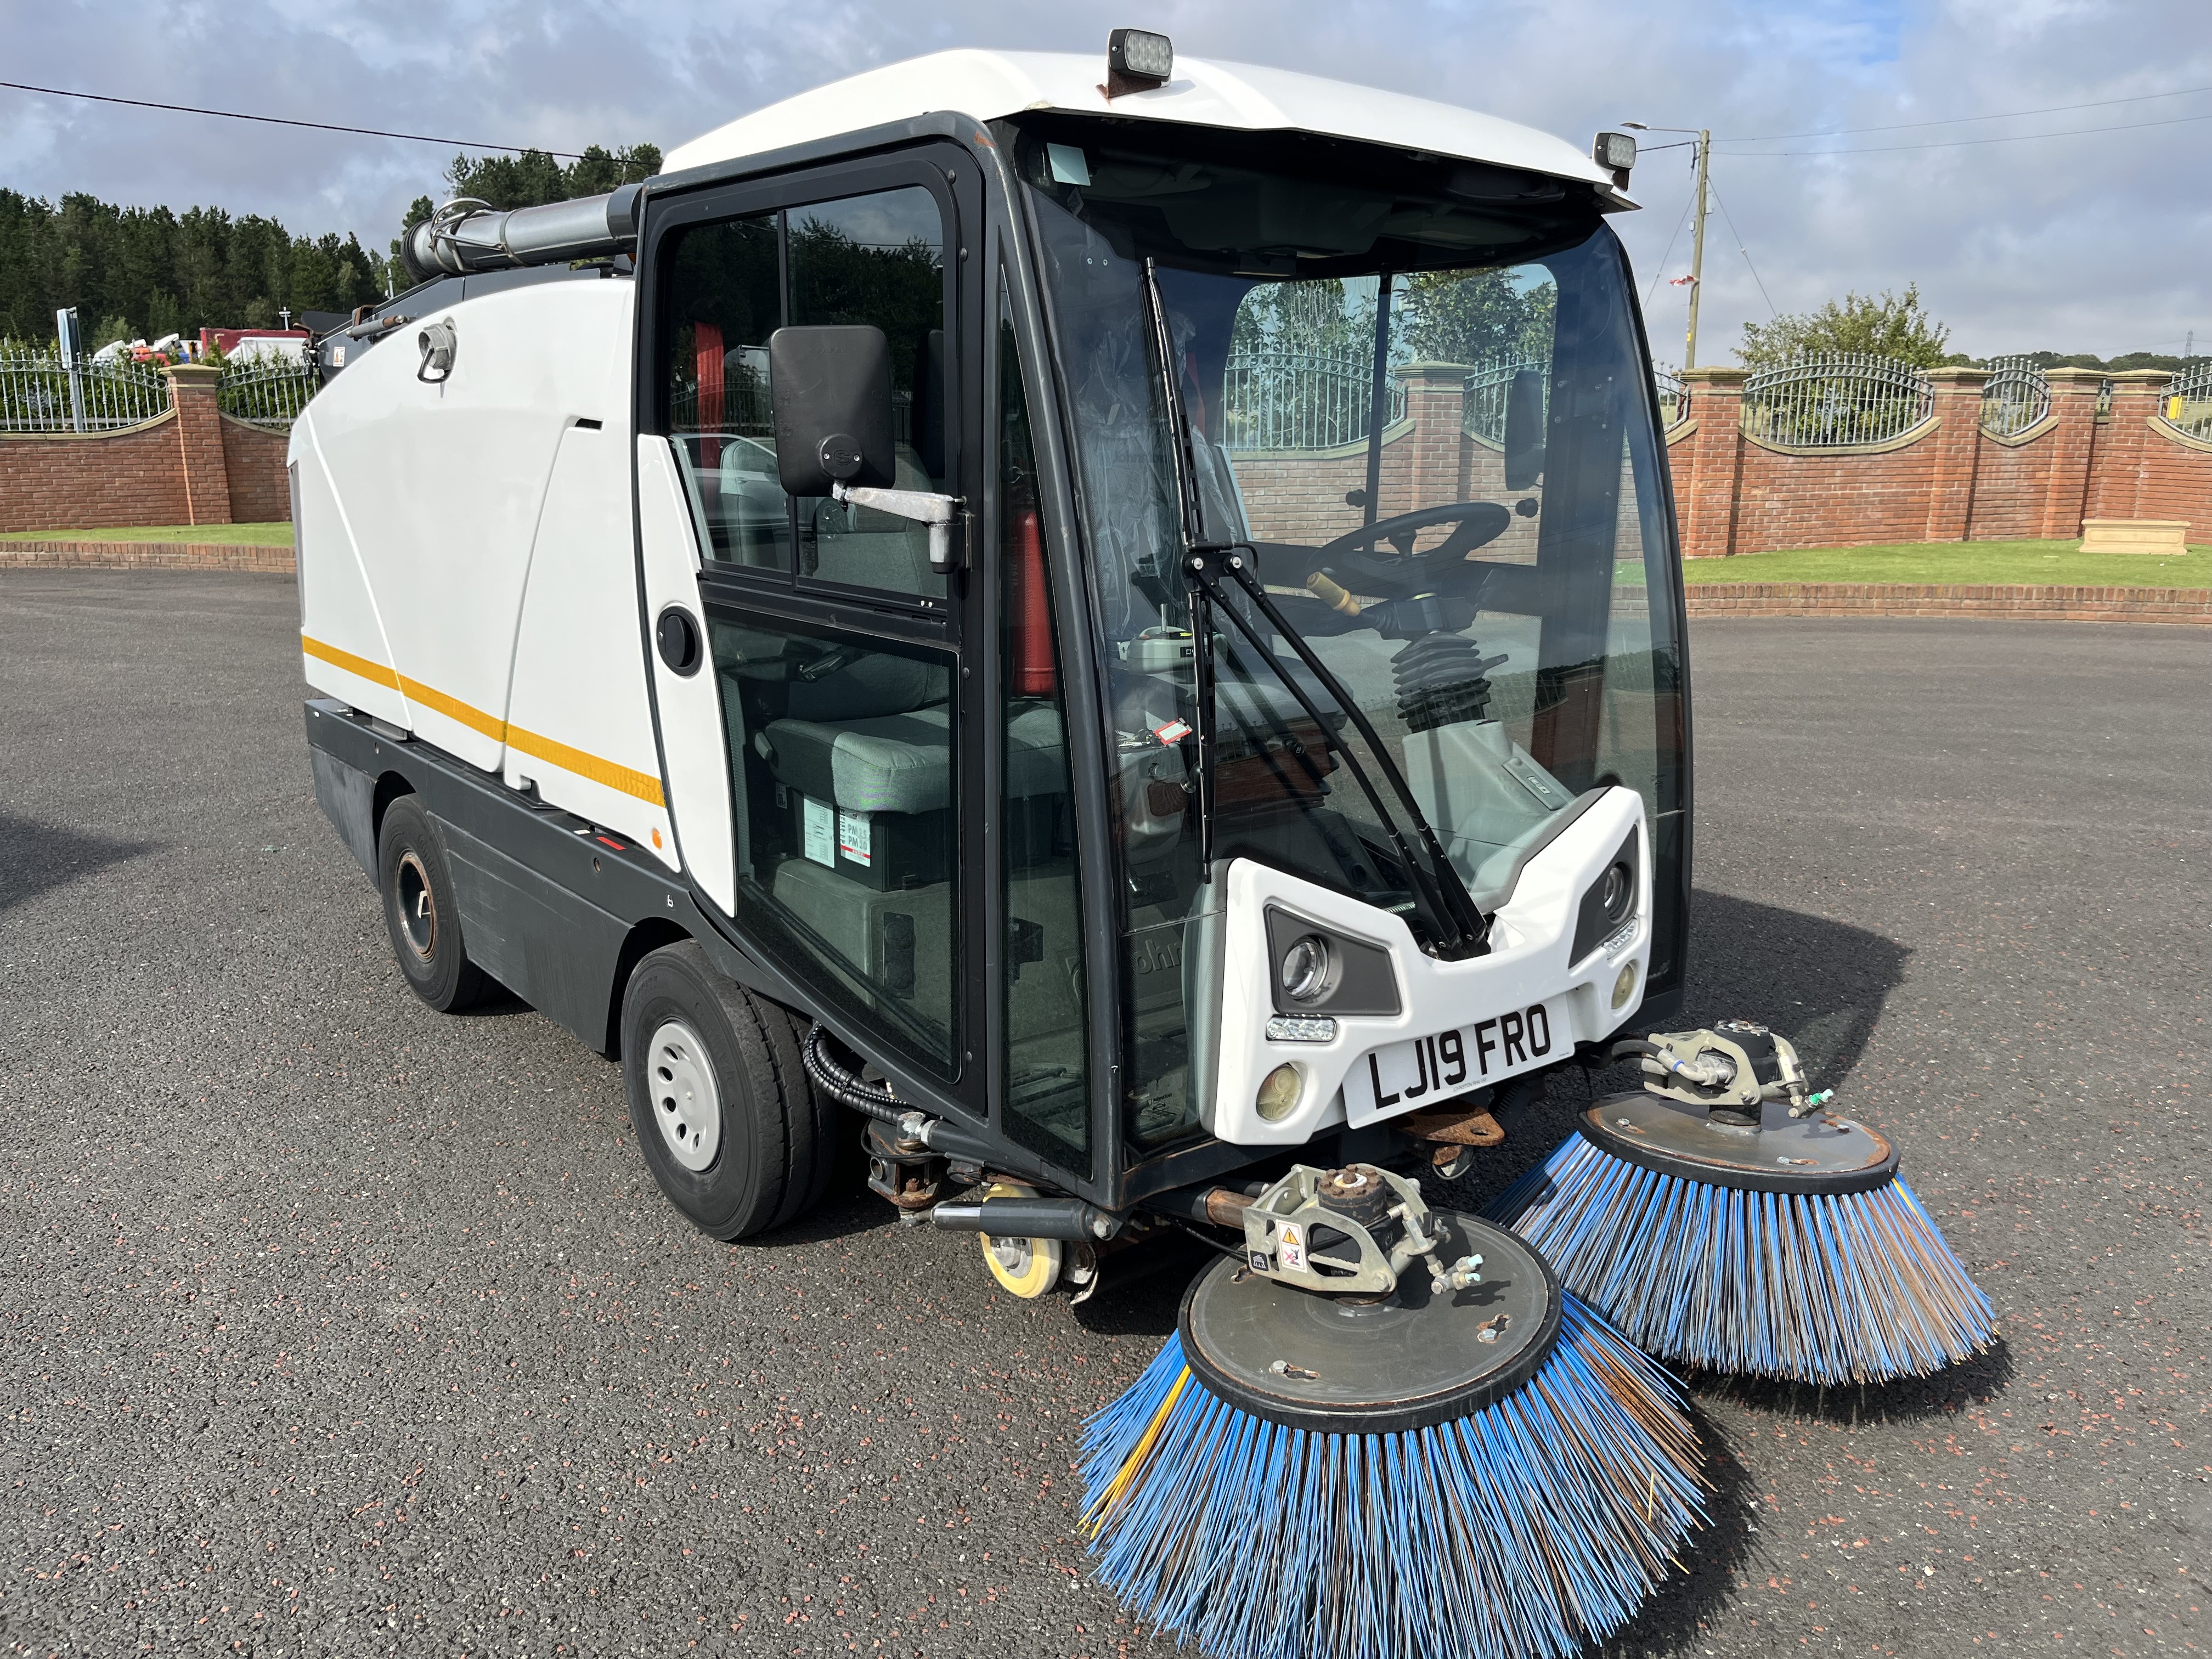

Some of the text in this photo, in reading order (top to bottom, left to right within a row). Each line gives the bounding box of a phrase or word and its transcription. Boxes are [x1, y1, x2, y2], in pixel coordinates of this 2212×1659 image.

[848, 823, 858, 835] PM
[848, 835, 859, 848] PM
[1368, 1003, 1551, 1109] LJ19 FRO
[1453, 1082, 1472, 1092] JOHNSTON
